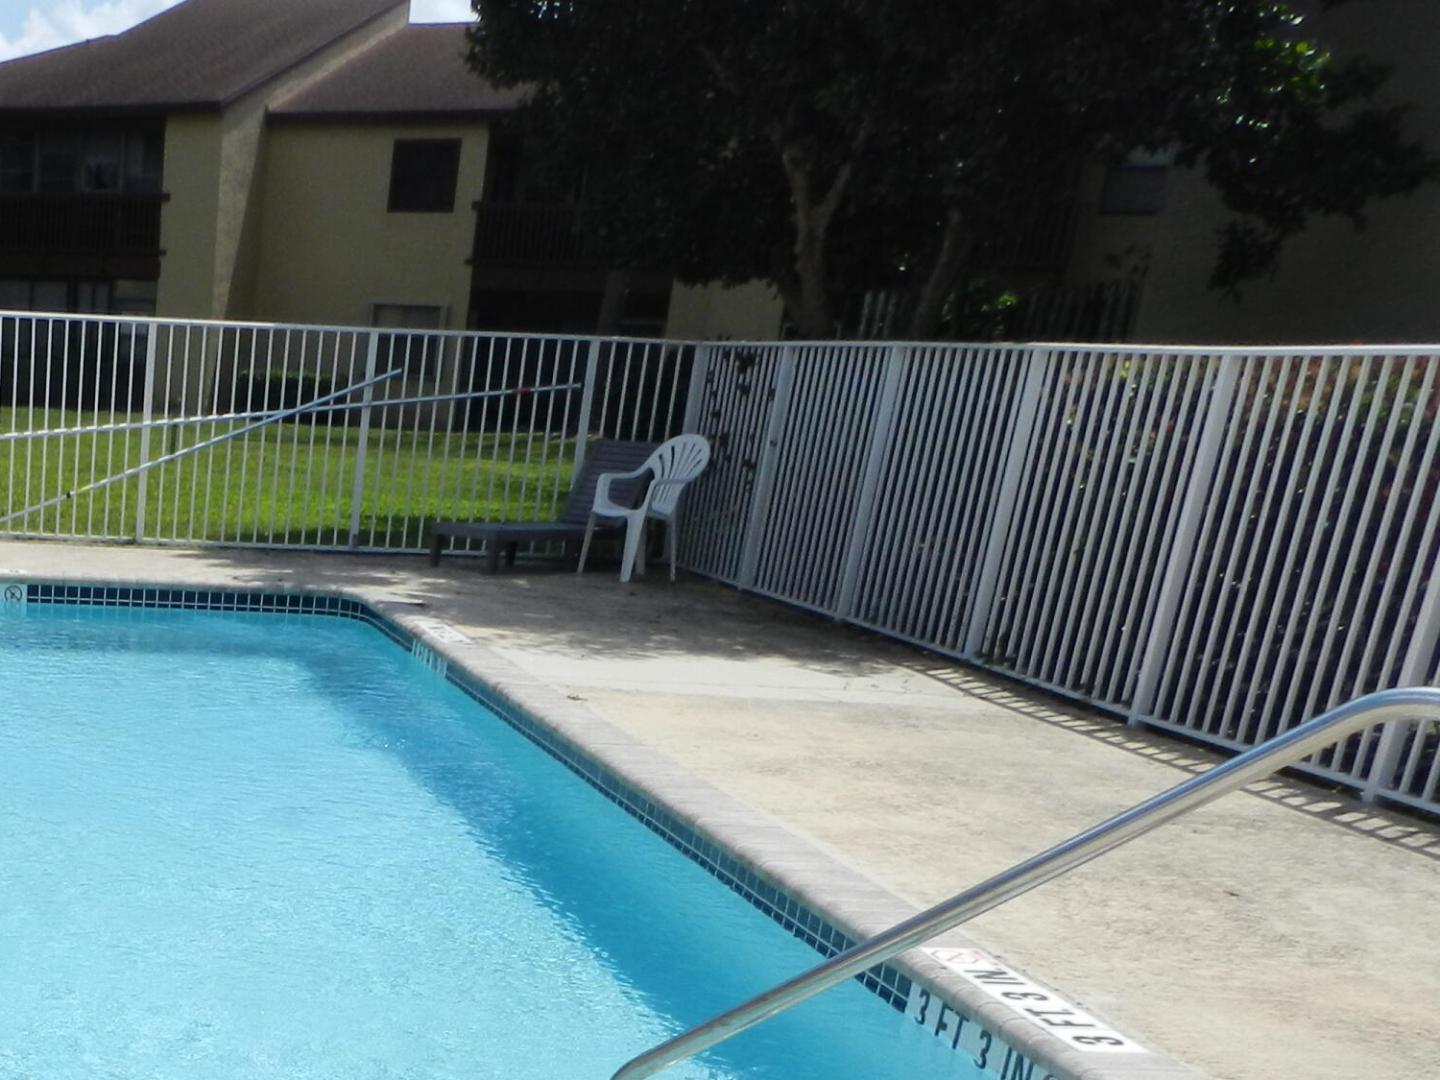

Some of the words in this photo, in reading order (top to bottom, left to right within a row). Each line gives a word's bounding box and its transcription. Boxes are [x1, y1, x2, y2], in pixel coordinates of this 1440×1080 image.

[1001, 991, 1049, 1001] 3
[914, 986, 931, 1026] 3
[934, 1001, 971, 1050] FT
[973, 1030, 993, 1070] 3
[1071, 1035, 1124, 1047] 3
